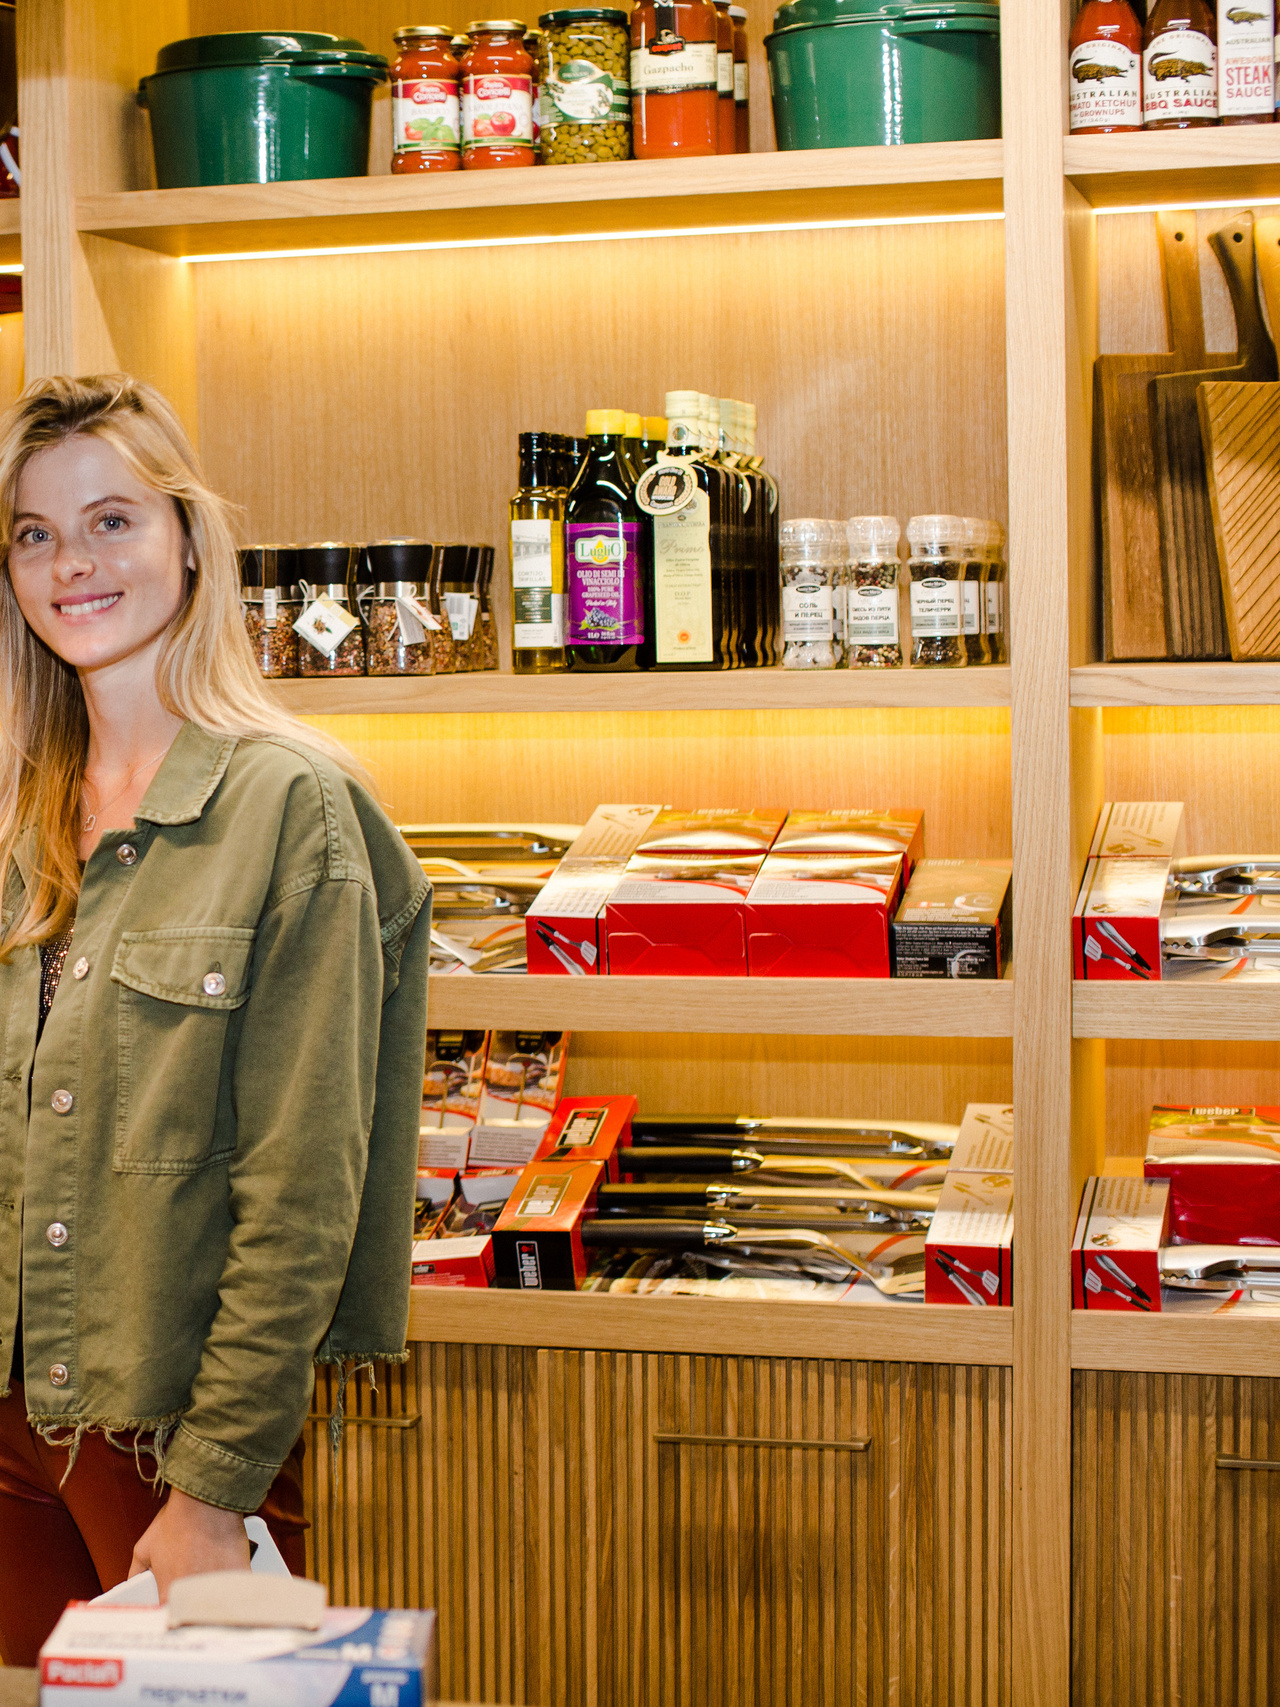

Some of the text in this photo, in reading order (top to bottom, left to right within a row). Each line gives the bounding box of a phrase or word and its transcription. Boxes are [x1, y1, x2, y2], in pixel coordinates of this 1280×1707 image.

[1169, 33, 1210, 46] ORIGINAL
[1225, 37, 1271, 45] AUSTRALIAN
[1086, 43, 1127, 54] ORIGINAL
[1225, 55, 1272, 65] AWESOME
[644, 63, 694, 75] Gazpacho
[1226, 64, 1272, 86] STEAK
[1226, 86, 1272, 99] SAUCE
[1095, 99, 1137, 107] KETCHUP
[1145, 100, 1168, 111] BBQ
[1173, 98, 1218, 108] SAUCE
[1080, 108, 1125, 118] GROWNUPS
[577, 570, 593, 579] OLIO
[601, 570, 617, 578] SEMI
[697, 807, 739, 815] weber
[830, 808, 874, 817] weber
[927, 859, 965, 867] weber
[1195, 1106, 1240, 1115] weber
[521, 1252, 539, 1287] weber
